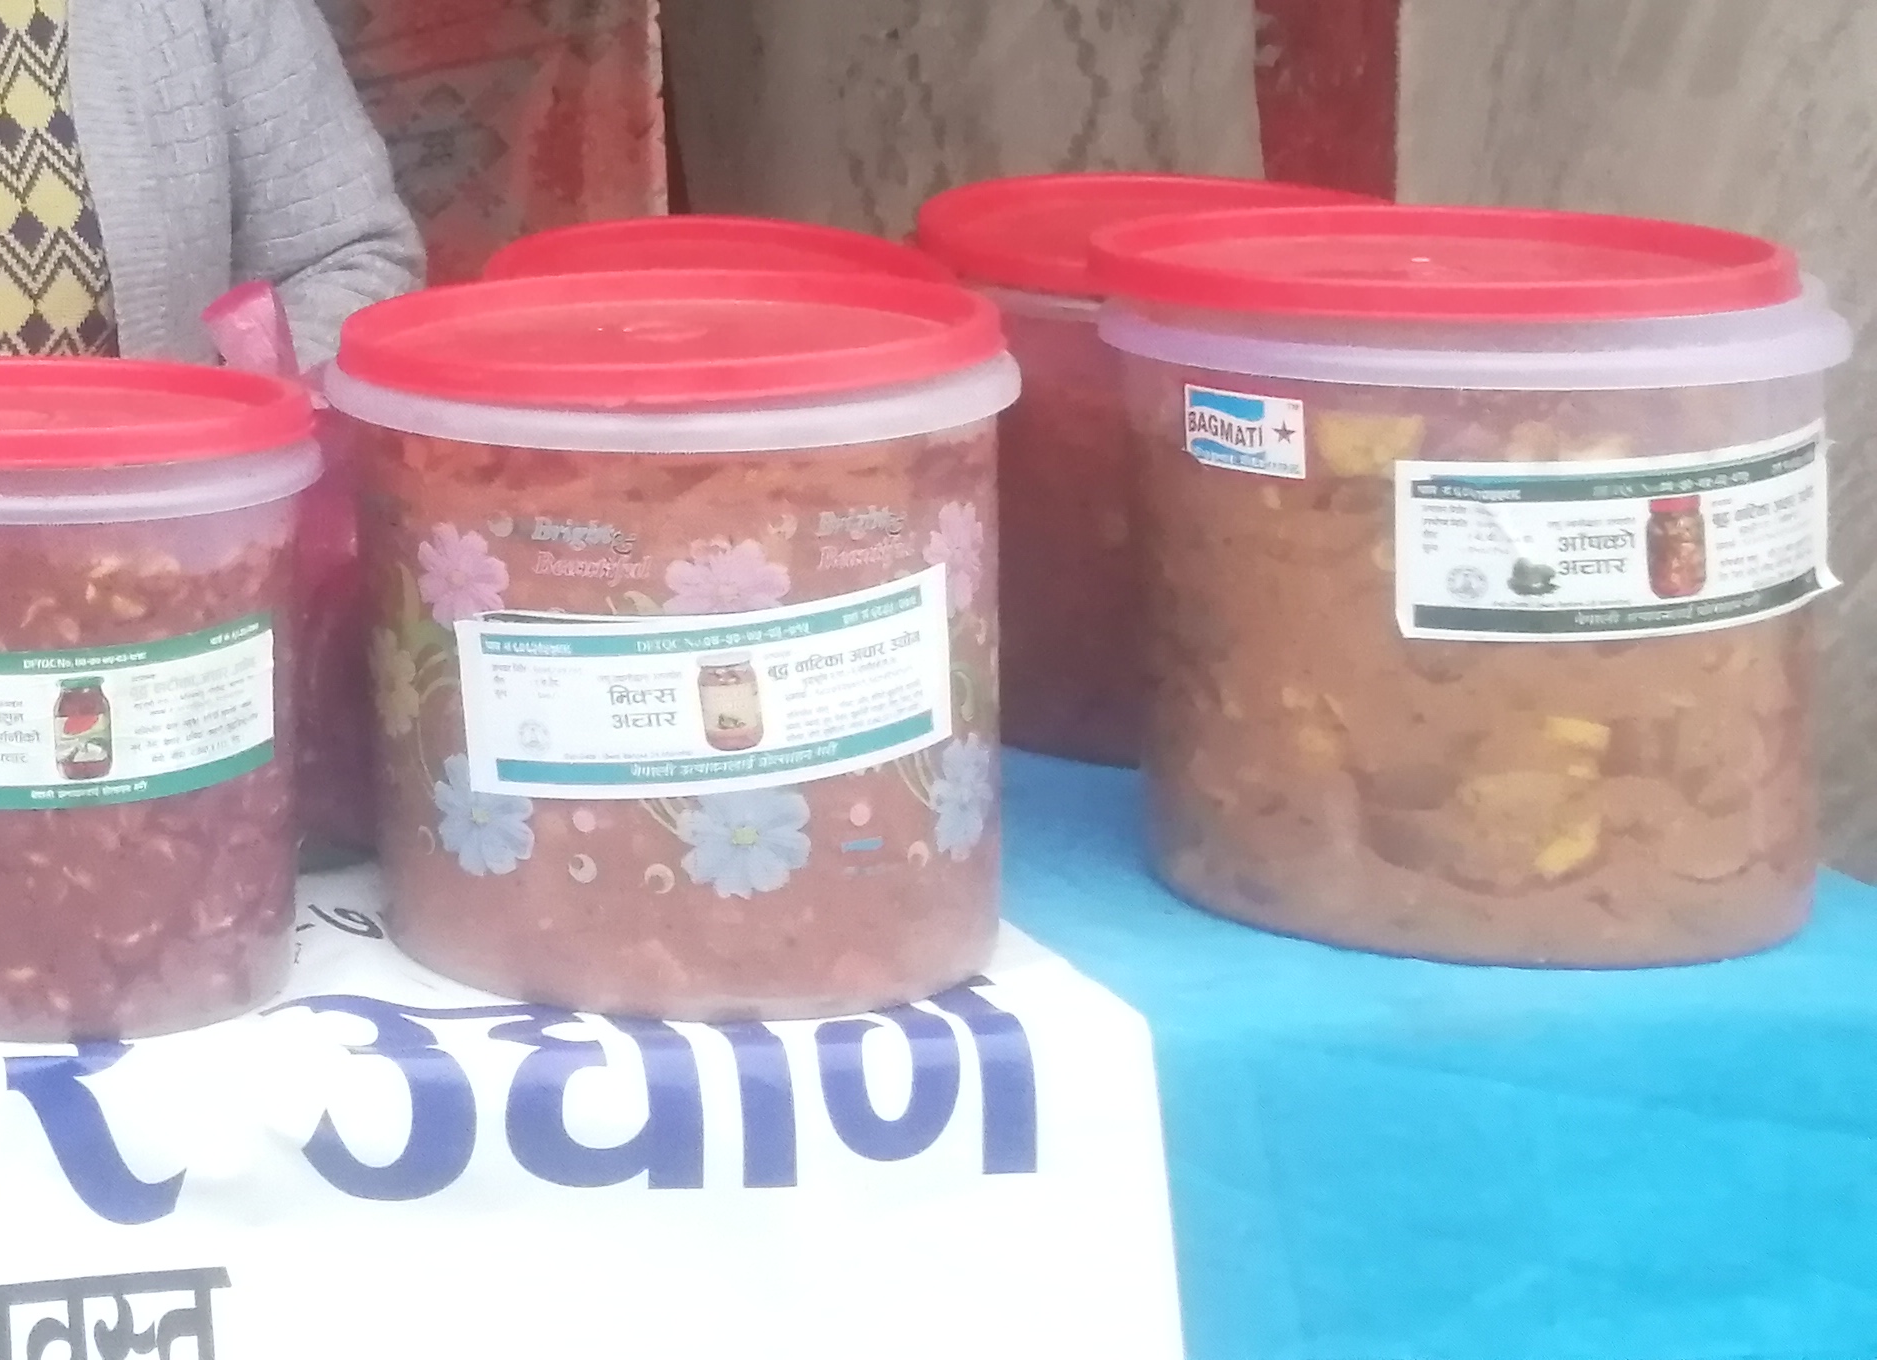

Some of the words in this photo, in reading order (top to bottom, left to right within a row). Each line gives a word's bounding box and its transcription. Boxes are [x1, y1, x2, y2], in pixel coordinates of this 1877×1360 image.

[1188, 411, 1263, 448] BAGMATI
[1558, 557, 1628, 577] अचार
[794, 652, 844, 674] वाटिका
[849, 642, 885, 664] अचार
[608, 684, 677, 706] मिक्स
[611, 711, 678, 730] अचार
